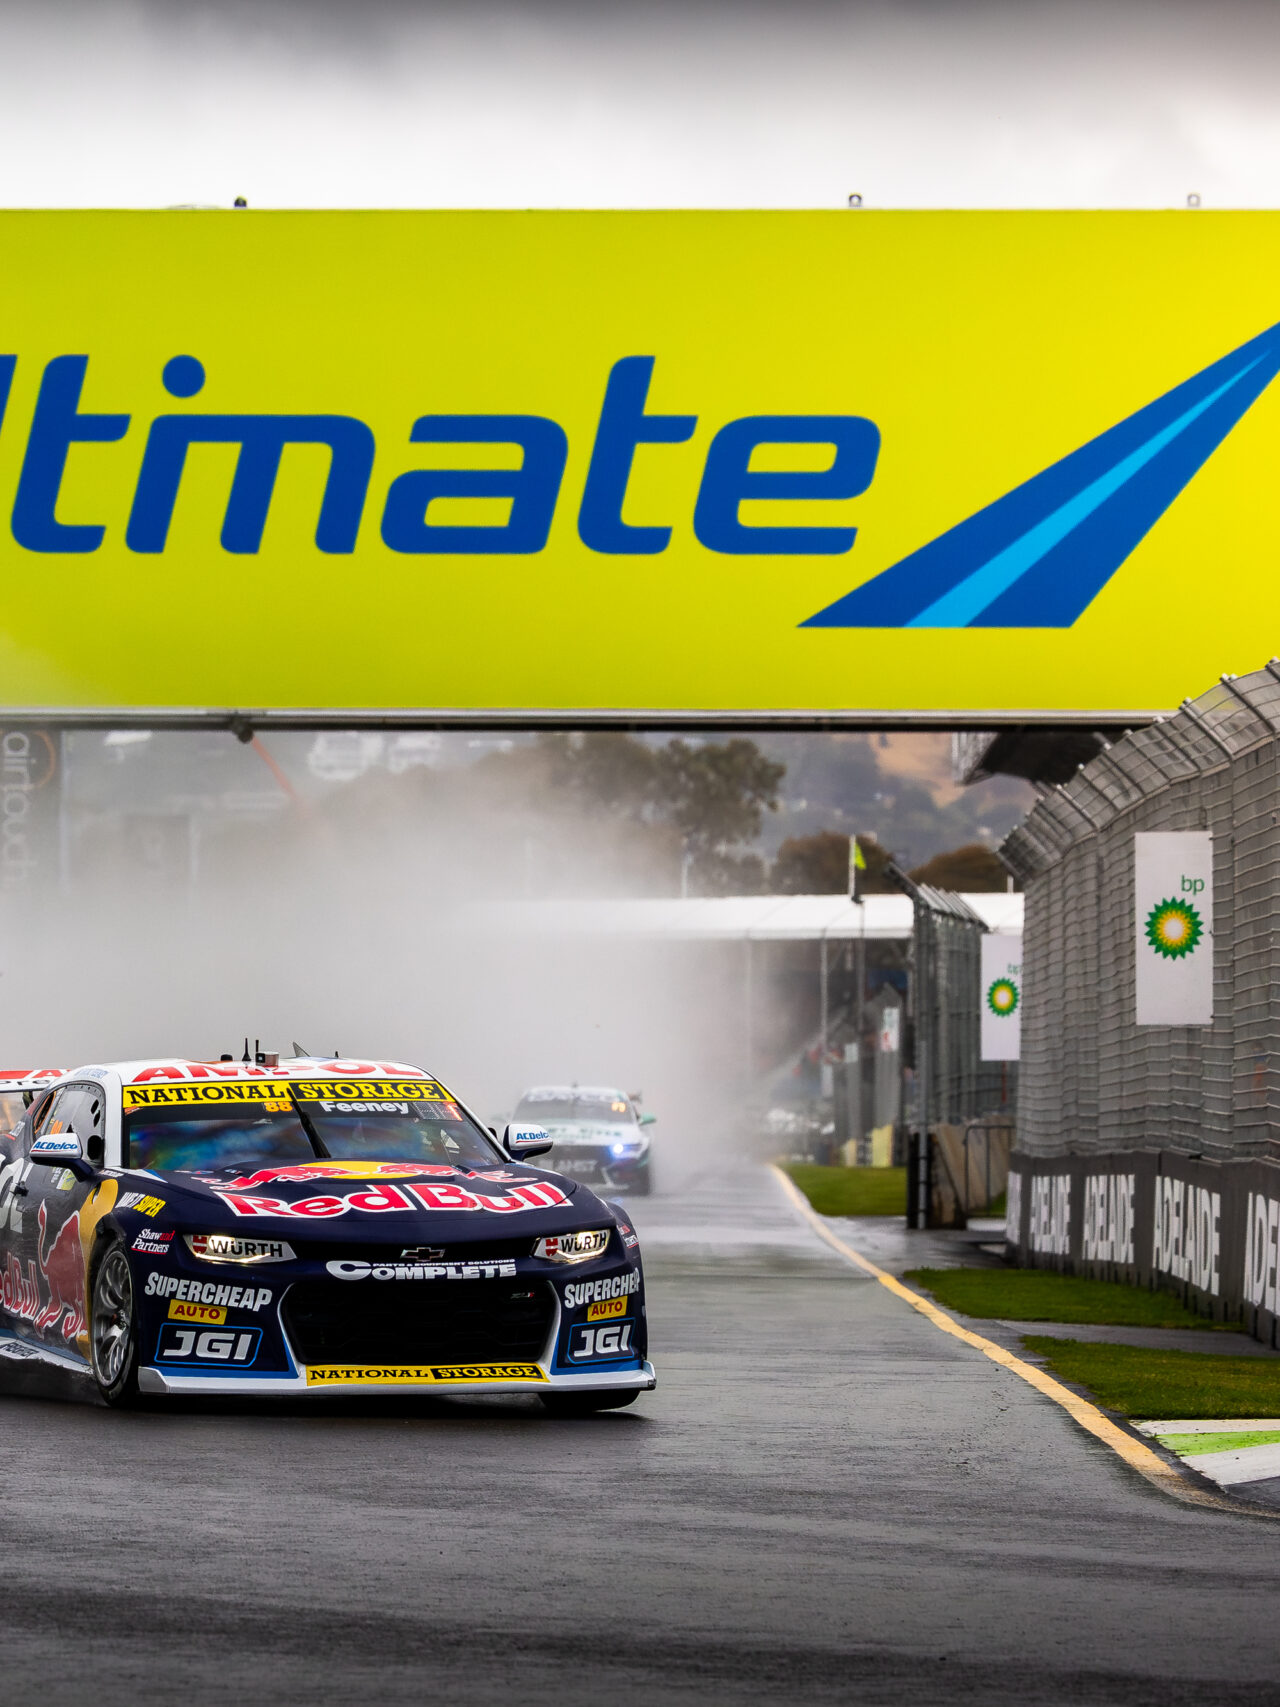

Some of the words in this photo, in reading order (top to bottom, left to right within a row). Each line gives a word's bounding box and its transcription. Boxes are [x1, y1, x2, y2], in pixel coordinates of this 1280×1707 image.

[1181, 875, 1205, 895] bp
[131, 1061, 423, 1083] AMPOL
[126, 1085, 285, 1104] NATIONAL
[300, 1082, 439, 1100] STORAGE
[265, 1100, 293, 1112] 88
[320, 1100, 409, 1115] Feeney
[516, 1131, 550, 1140] ACDelc
[33, 1141, 78, 1150] ACDelco
[213, 1183, 418, 1218] Red
[403, 1181, 574, 1213] Bull
[138, 1228, 162, 1240] Shaw
[1152, 1175, 1220, 1296] ADELAIDE
[131, 1237, 170, 1253] Partners
[325, 1260, 517, 1281] COMPLETE
[144, 1271, 272, 1312] SUPERCHEAP
[173, 1304, 220, 1320] AUTO
[591, 1301, 623, 1316] AUTO
[162, 1330, 253, 1360] JGI
[573, 1325, 632, 1357] JGI
[310, 1368, 430, 1380] NATIONAL
[440, 1366, 538, 1379] STORAGE
